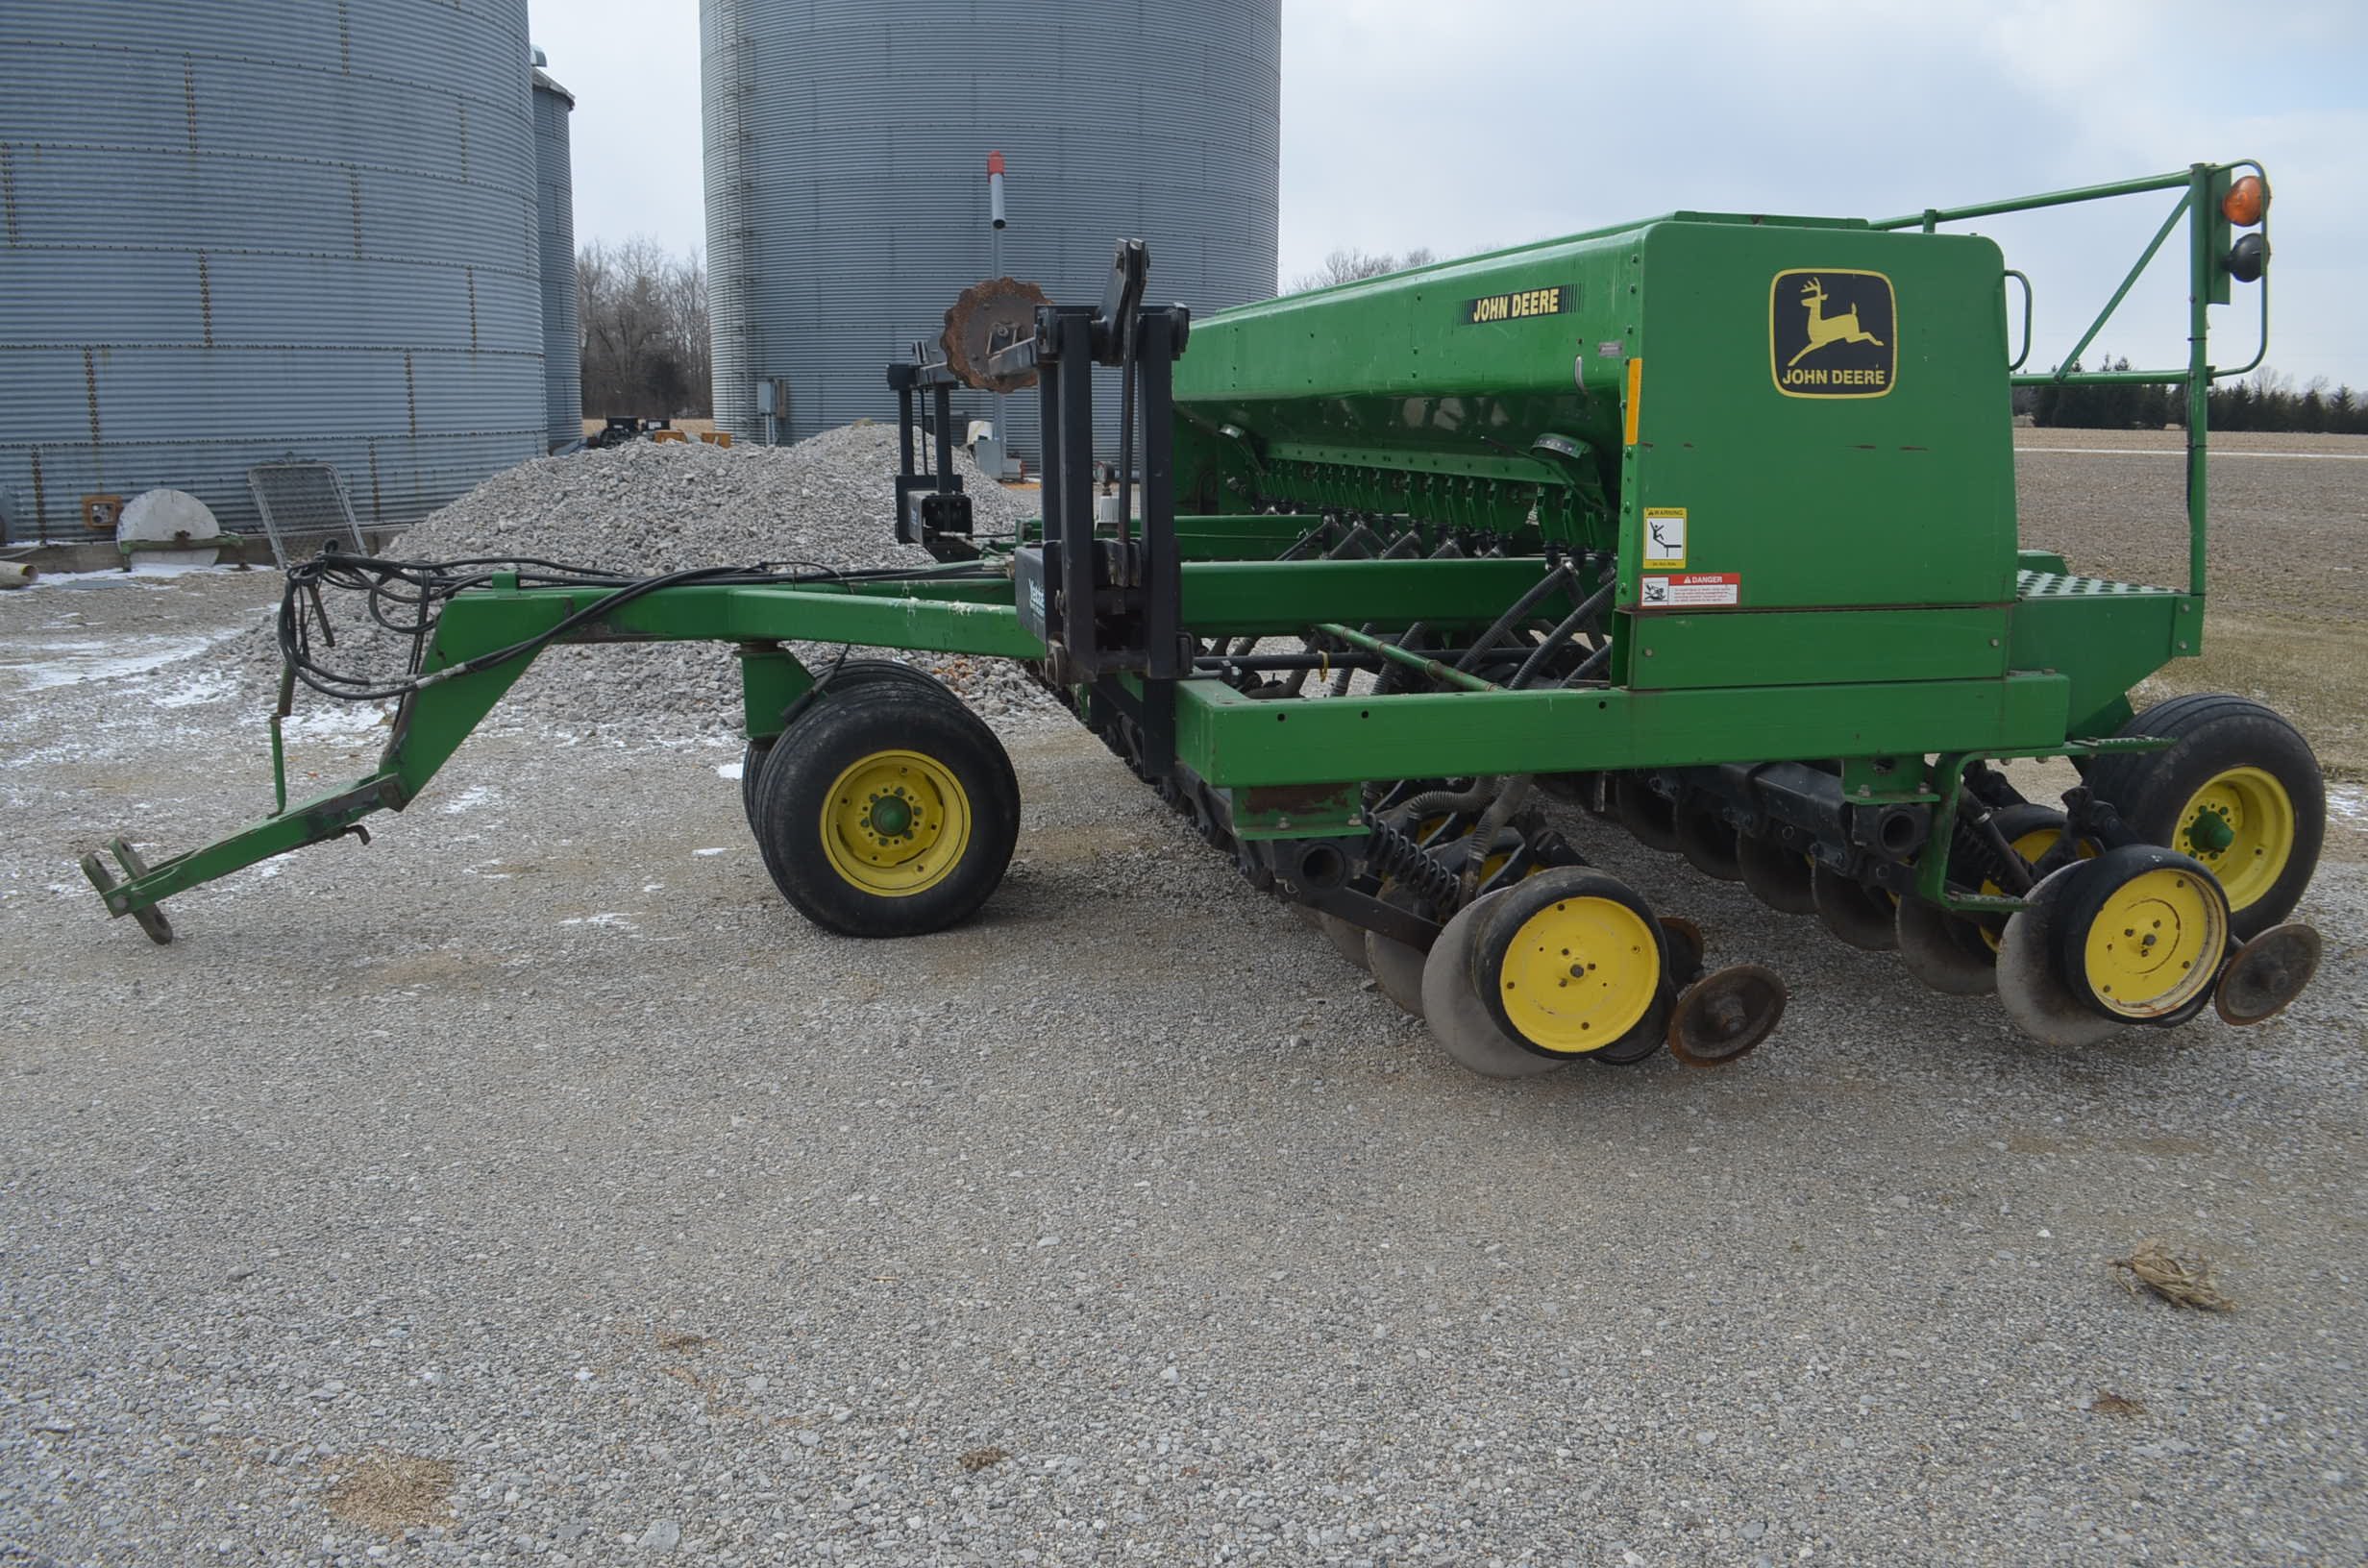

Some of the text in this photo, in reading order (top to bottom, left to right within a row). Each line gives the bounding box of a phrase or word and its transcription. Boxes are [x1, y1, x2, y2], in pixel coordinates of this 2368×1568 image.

[1473, 288, 1559, 323] JOHN DEERE
[1783, 369, 1886, 384] JOHN DEERE
